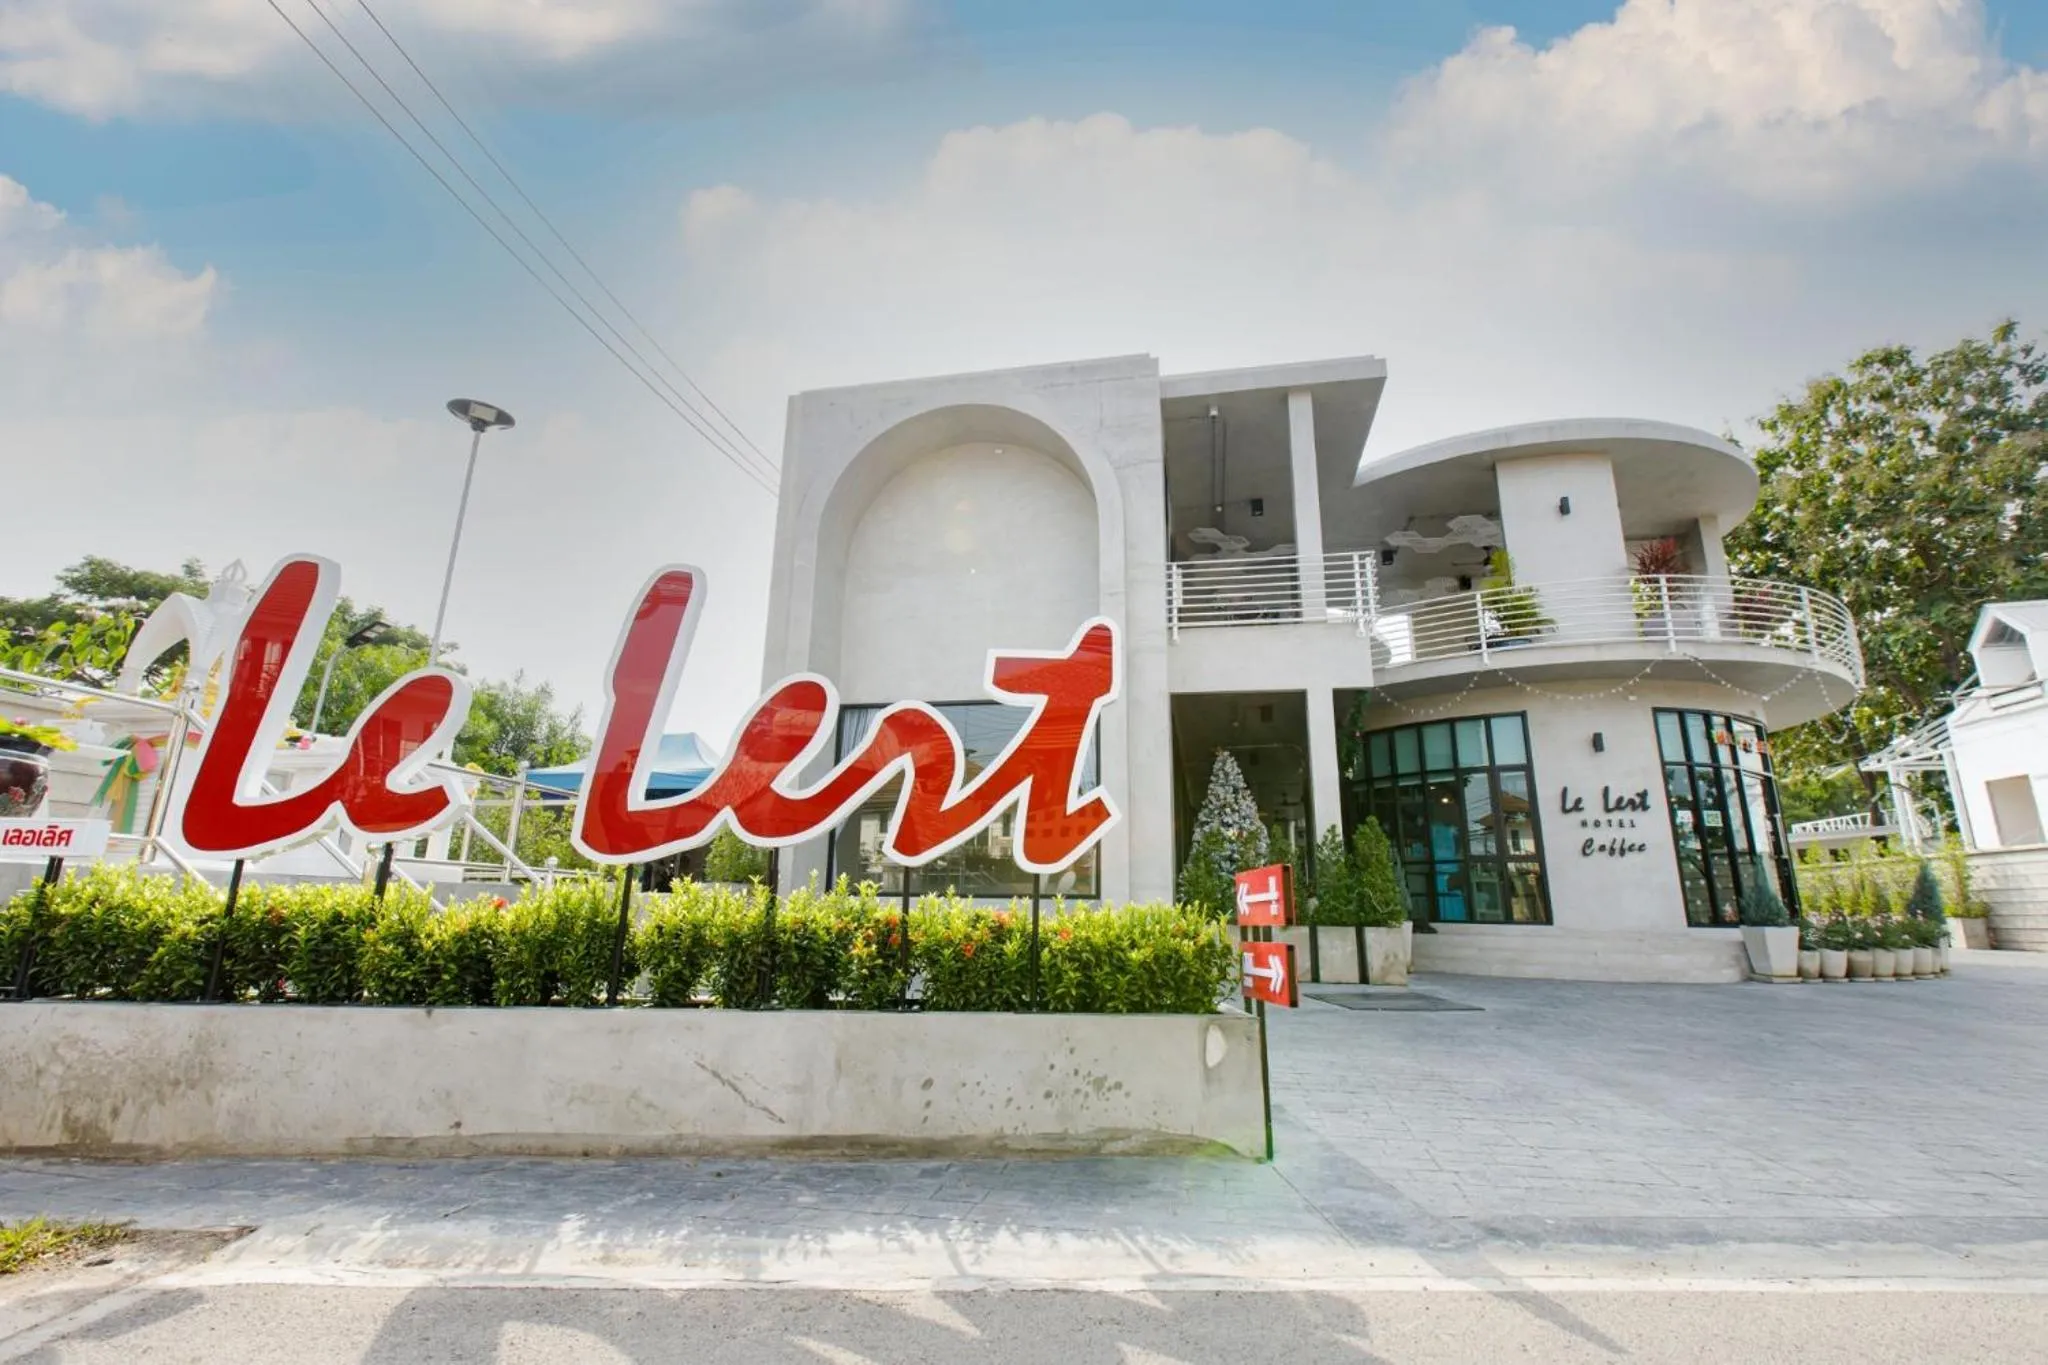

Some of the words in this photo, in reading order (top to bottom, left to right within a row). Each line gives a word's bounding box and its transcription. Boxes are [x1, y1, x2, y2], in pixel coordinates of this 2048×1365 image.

[183, 554, 470, 858] Le
[1561, 786, 1585, 814] Le
[1580, 818, 1636, 829] HOTEL
[1, 824, 74, 848] เลอเลิศ
[1581, 837, 1647, 858] Coffee
